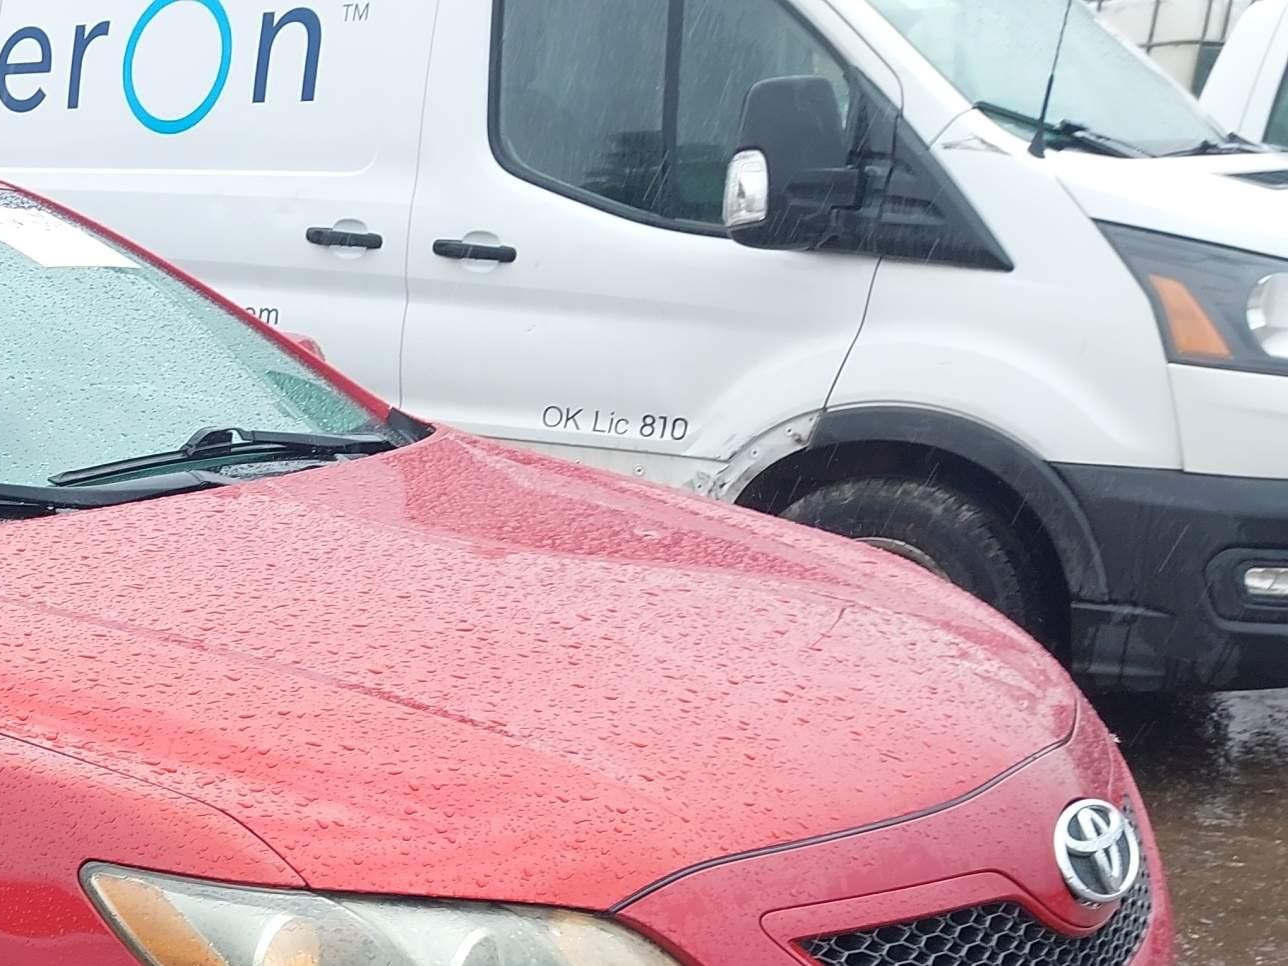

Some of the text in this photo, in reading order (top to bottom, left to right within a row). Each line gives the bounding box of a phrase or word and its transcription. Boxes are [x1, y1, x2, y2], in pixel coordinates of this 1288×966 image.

[343, 3, 370, 22] TM
[542, 405, 688, 440] OK Lic 810
